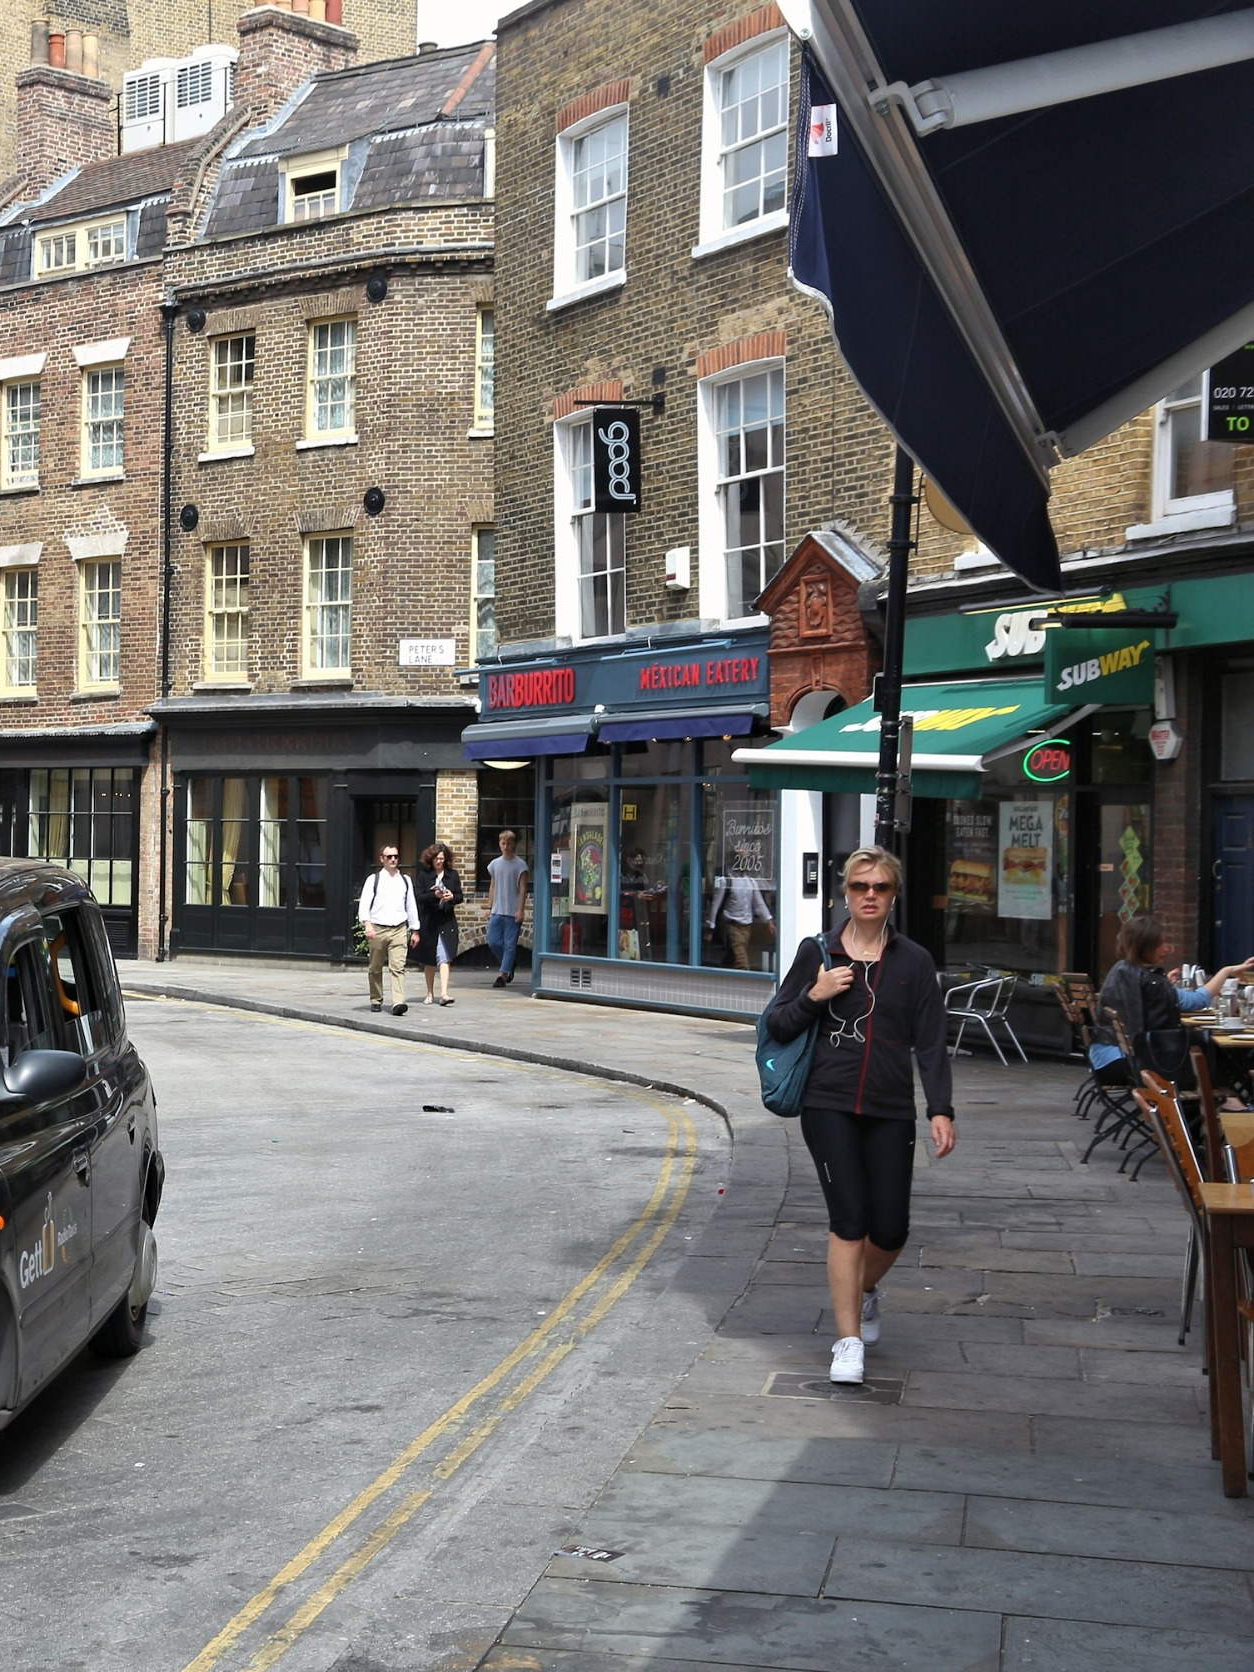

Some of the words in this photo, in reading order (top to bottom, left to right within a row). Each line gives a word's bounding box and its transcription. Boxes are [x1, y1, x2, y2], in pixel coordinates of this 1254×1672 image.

[1214, 387, 1237, 399] 020
[1226, 416, 1250, 431] TO
[408, 655, 433, 664] LANE
[1056, 640, 1151, 692] SUBWAY
[487, 668, 577, 709] BARBURRITO
[705, 657, 760, 686] EATERY
[1030, 750, 1071, 771] OPEN
[725, 818, 772, 837] Burritos
[1009, 815, 1044, 832] MEGA
[734, 840, 763, 853] since
[1011, 833, 1042, 848] MELT
[732, 855, 764, 872] 2005
[19, 1239, 43, 1289] Gett
